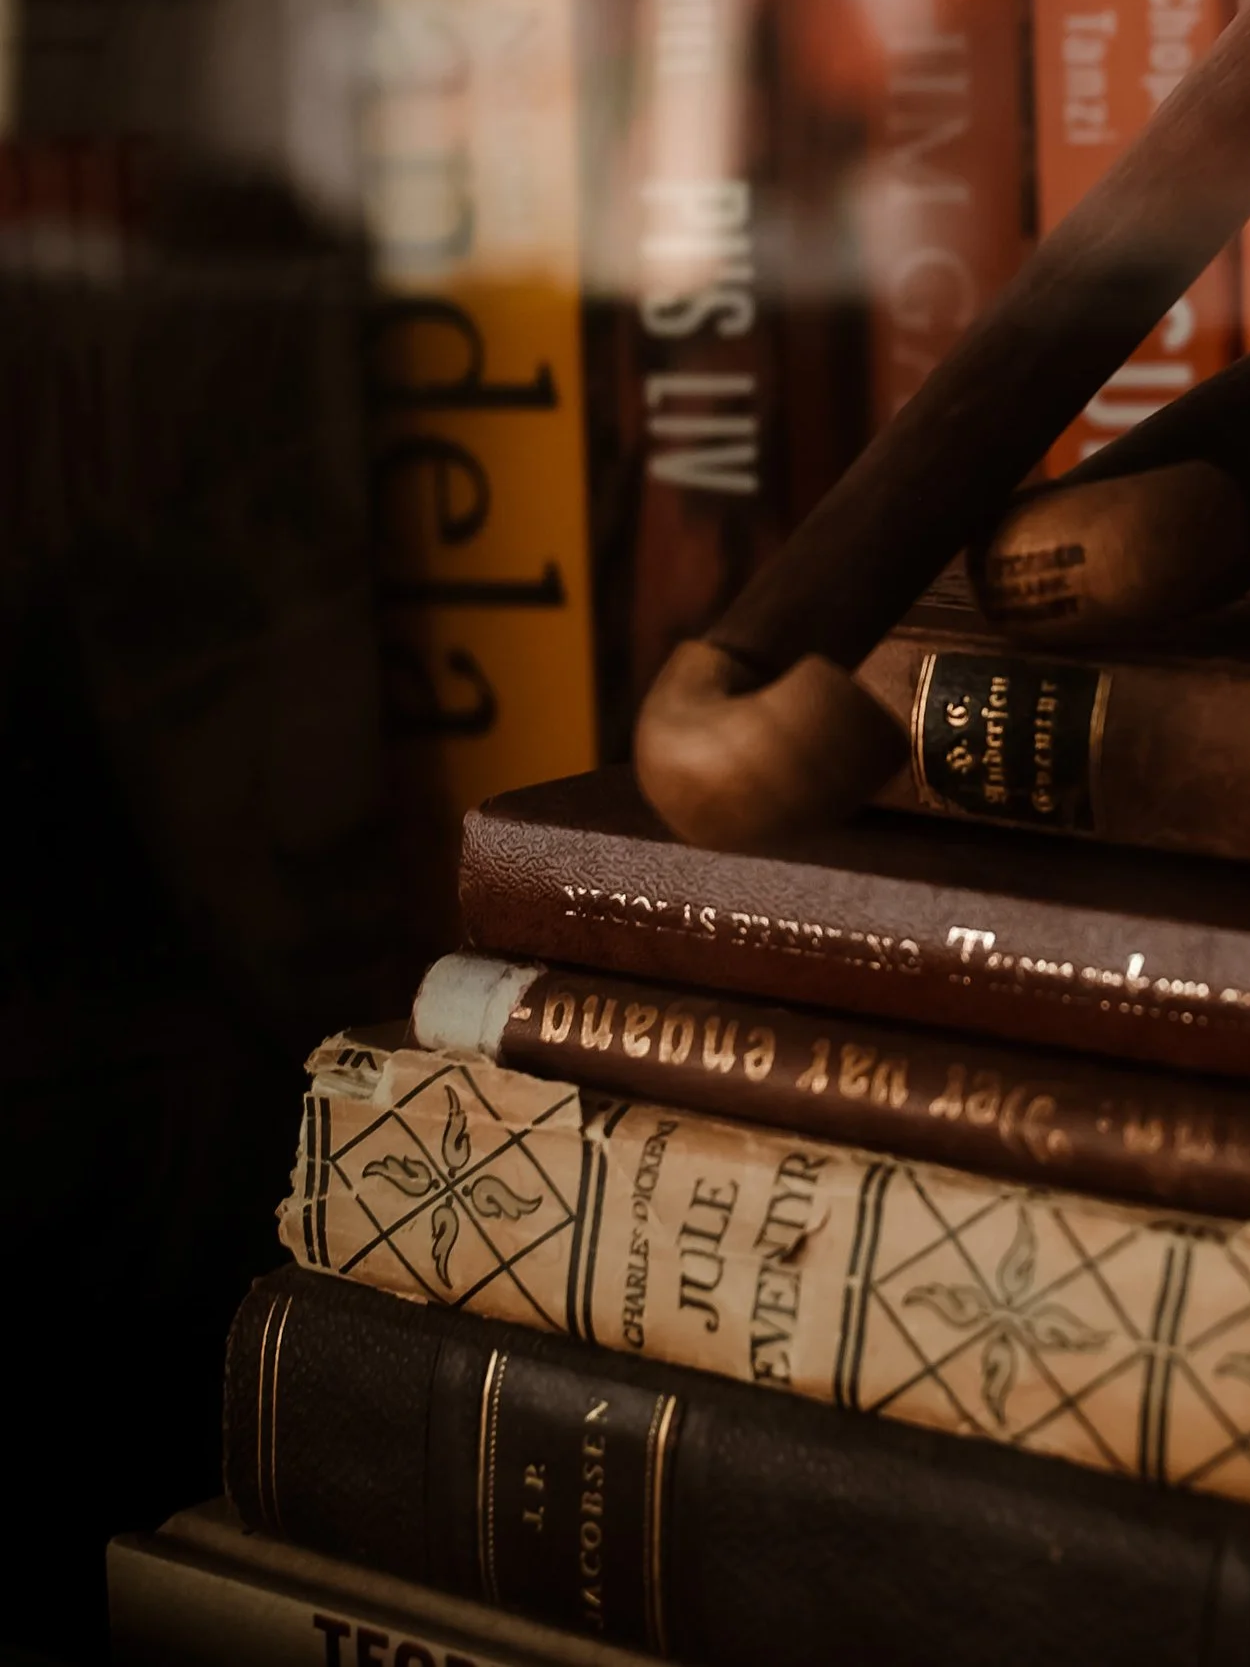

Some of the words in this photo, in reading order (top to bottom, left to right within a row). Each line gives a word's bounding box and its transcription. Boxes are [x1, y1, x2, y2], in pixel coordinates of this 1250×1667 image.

[1061, 11, 1117, 145] Tanzi
[645, 371, 760, 496] LIV
[677, 1177, 741, 1333] JULE
[749, 1152, 828, 1386] EVENTYR
[580, 1396, 609, 1631] JACOBSEN
